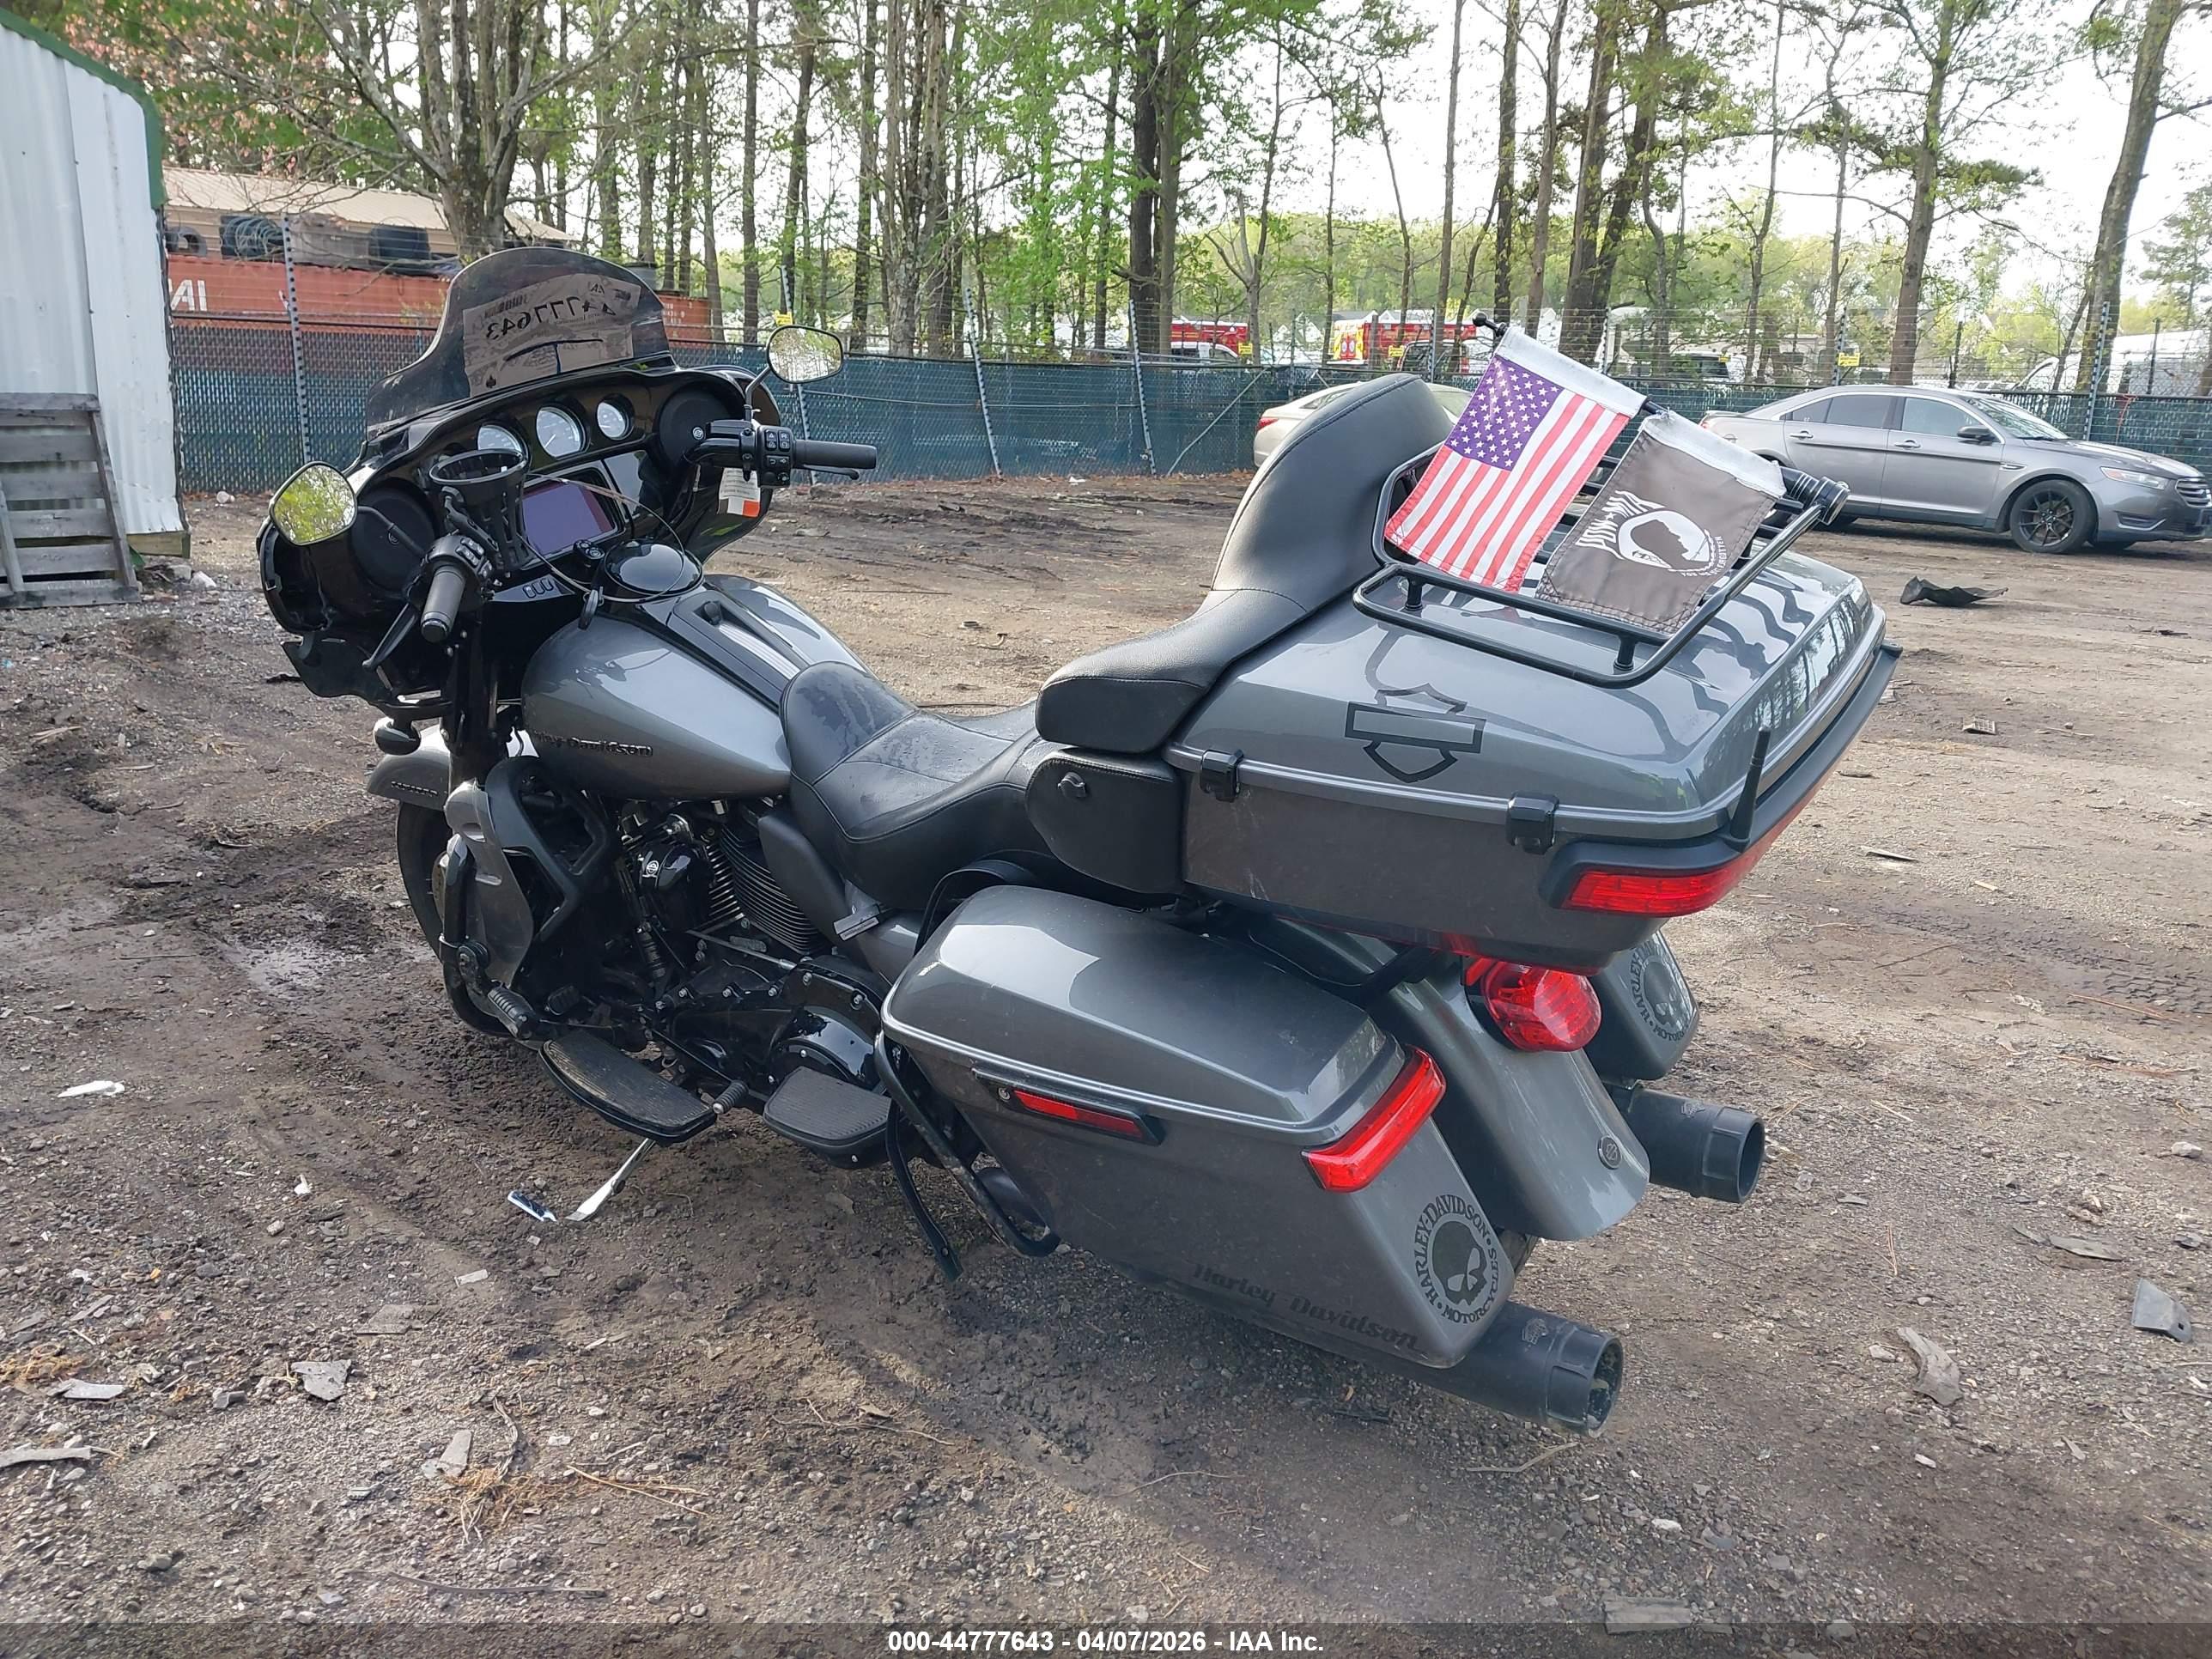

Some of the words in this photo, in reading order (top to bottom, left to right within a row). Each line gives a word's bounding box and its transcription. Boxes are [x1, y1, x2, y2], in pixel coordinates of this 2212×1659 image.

[168, 279, 208, 312] AI
[1575, 519, 1626, 560] POW
[1601, 490, 1667, 519] MIA
[1414, 1194, 1491, 1305] HARLEY-DAVIDSON
[1441, 1248, 1499, 1324] MOTORCYCLES
[1193, 1262, 1276, 1308] Harley
[1289, 1297, 1424, 1351] Davidson
